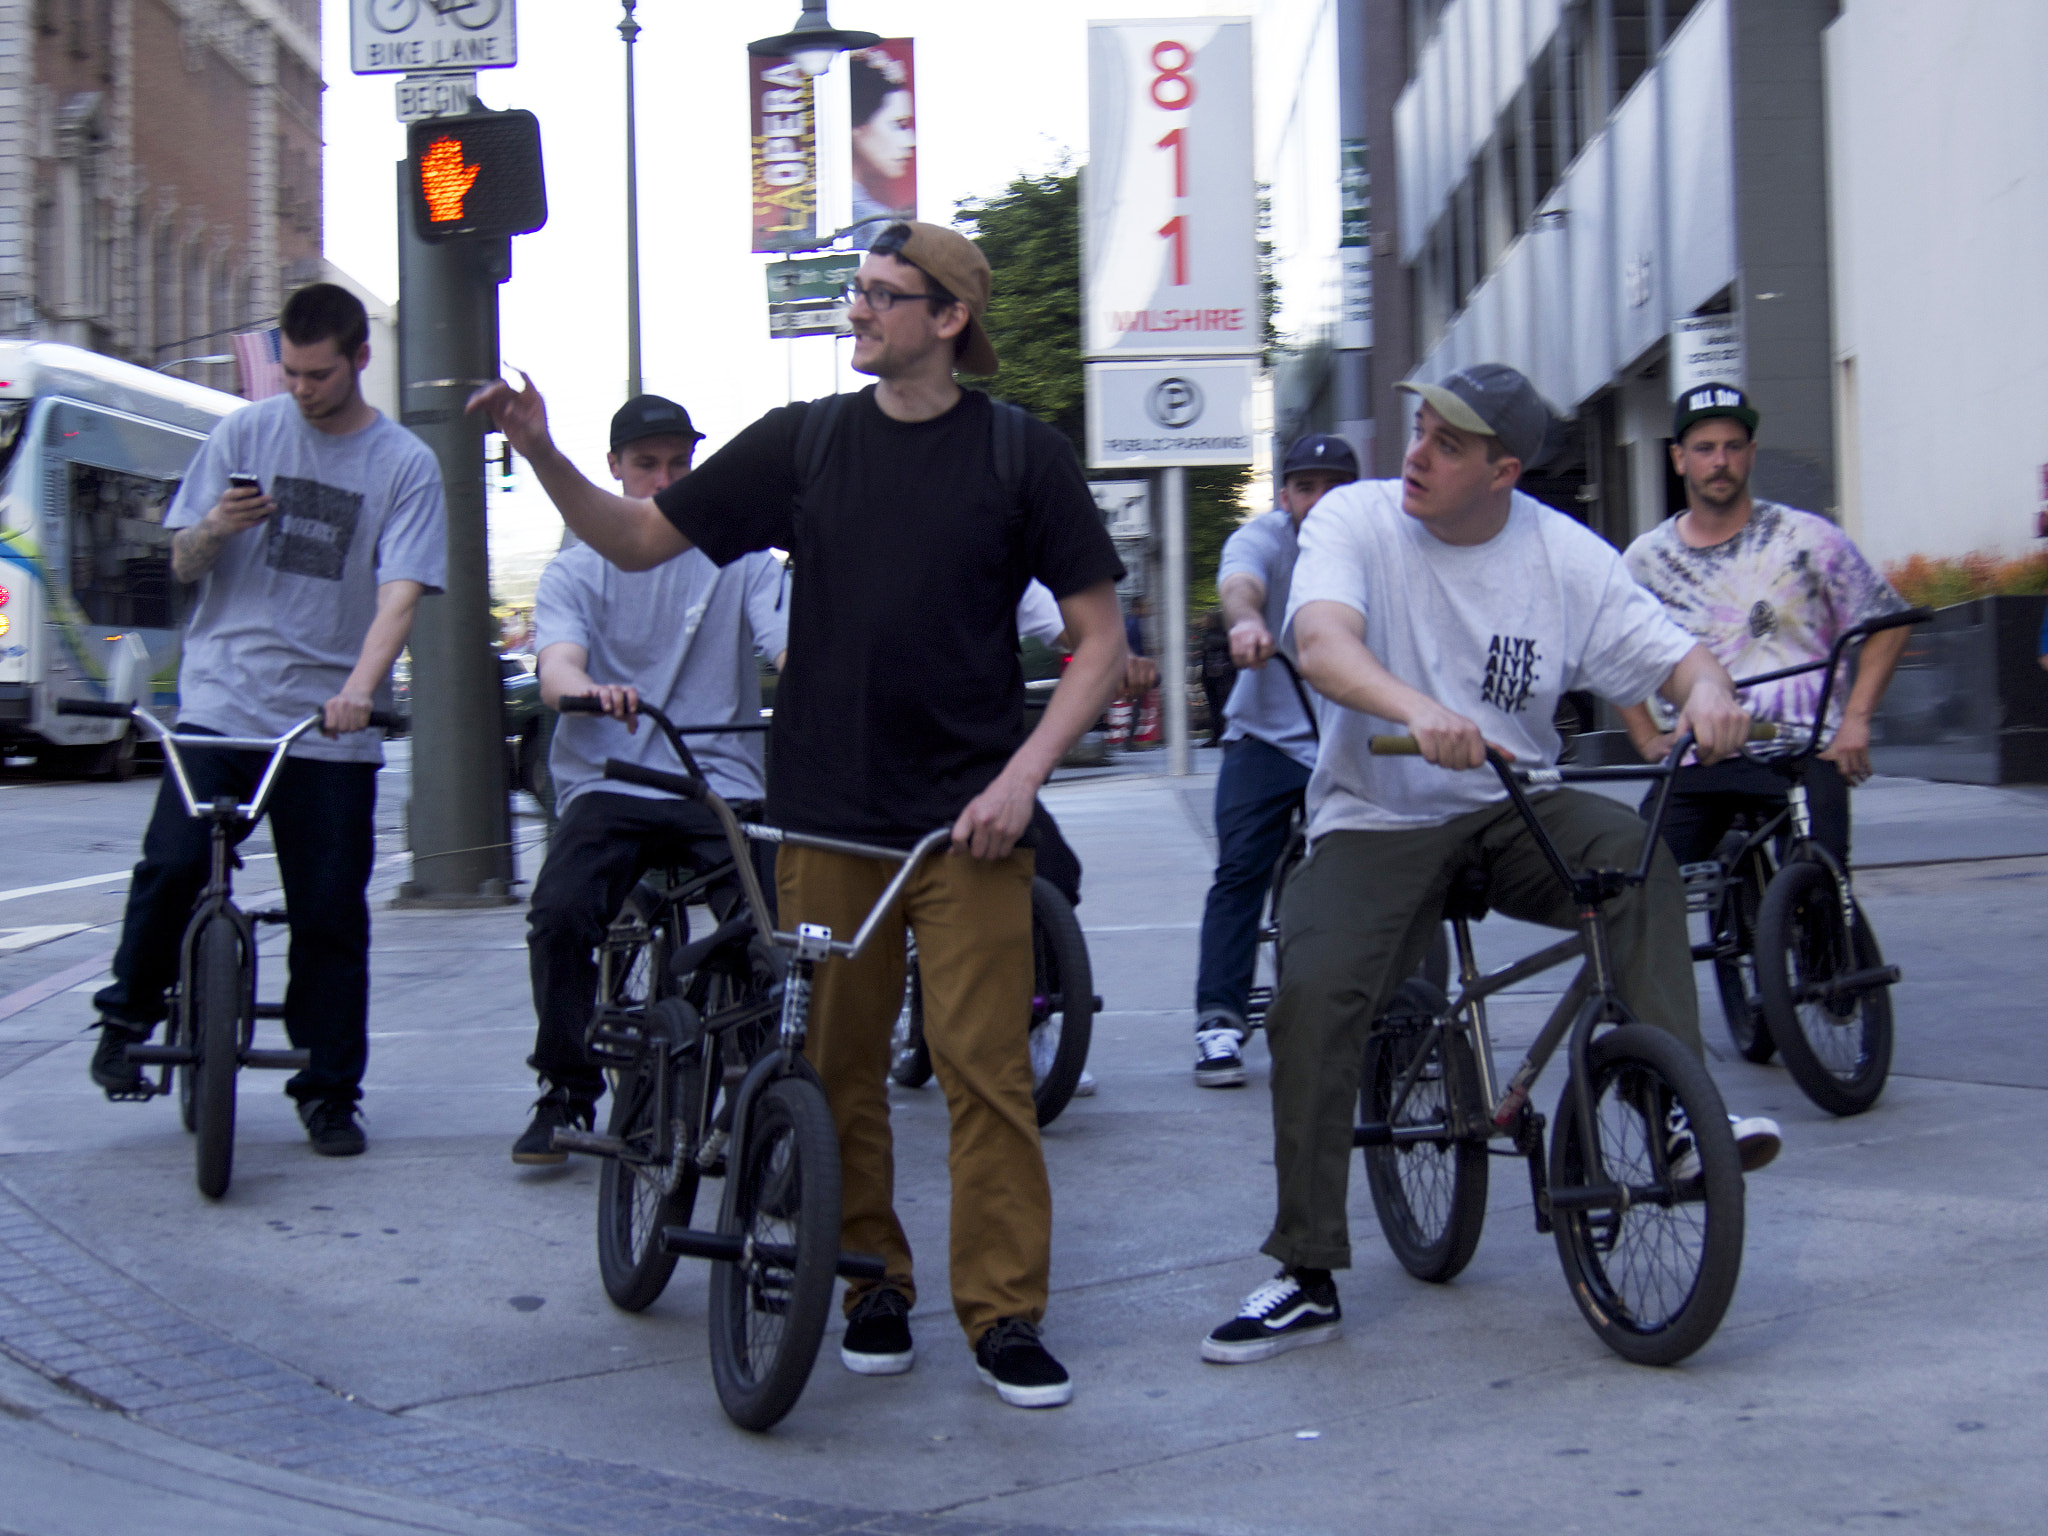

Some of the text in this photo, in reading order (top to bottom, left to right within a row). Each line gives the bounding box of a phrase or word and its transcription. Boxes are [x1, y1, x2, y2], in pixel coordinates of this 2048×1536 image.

[366, 37, 498, 67] BIKE LANE
[400, 84, 472, 116] BEGIN
[760, 62, 809, 186] OPERA
[1104, 308, 1246, 332] WILSHIRE
[1689, 388, 1741, 411] ALL DAY
[1489, 634, 1542, 660] ALYK.
[1485, 655, 1540, 680] ALYK.
